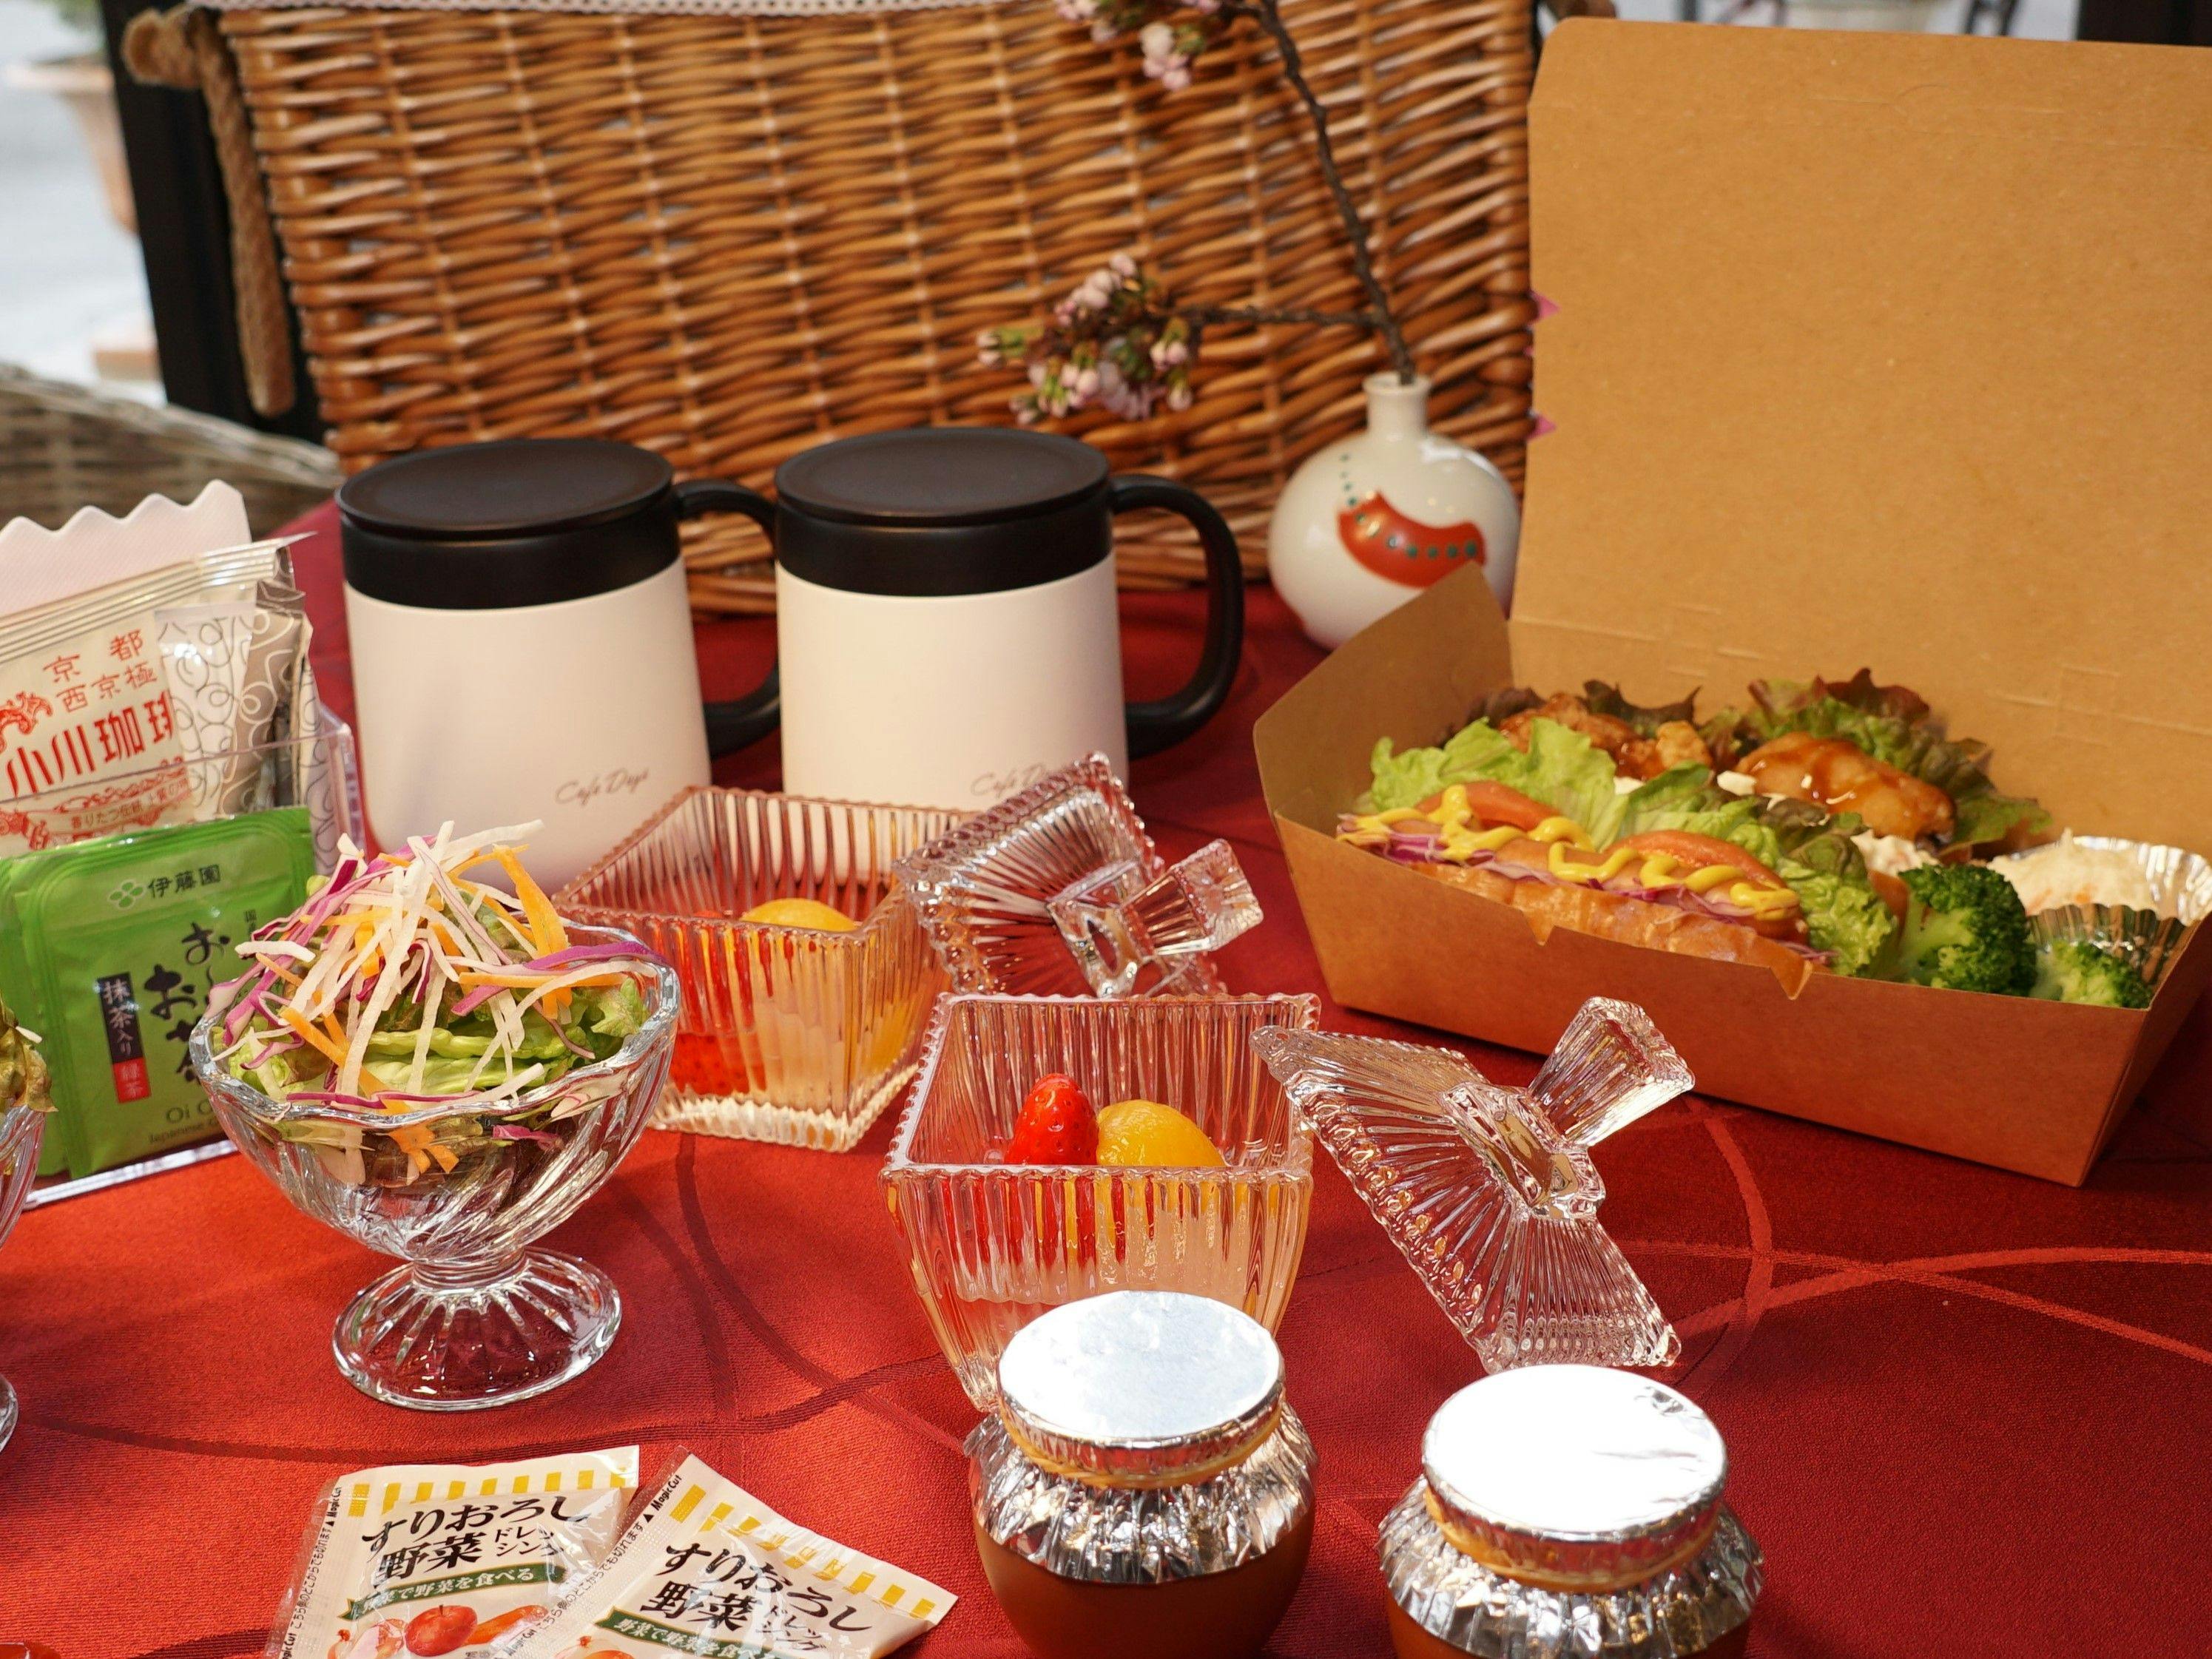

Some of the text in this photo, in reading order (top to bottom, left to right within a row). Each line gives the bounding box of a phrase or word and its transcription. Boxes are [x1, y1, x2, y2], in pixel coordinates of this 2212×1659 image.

[43, 629, 144, 683] 京都
[55, 661, 157, 714] 西京極
[148, 864, 221, 899] 伊藤園
[650, 1475, 682, 1511] Magic Cut
[361, 1496, 593, 1564] すりおろし
[373, 1531, 488, 1589] 野菜
[640, 1581, 763, 1631] 野菜
[655, 1542, 873, 1632] すりおろし
